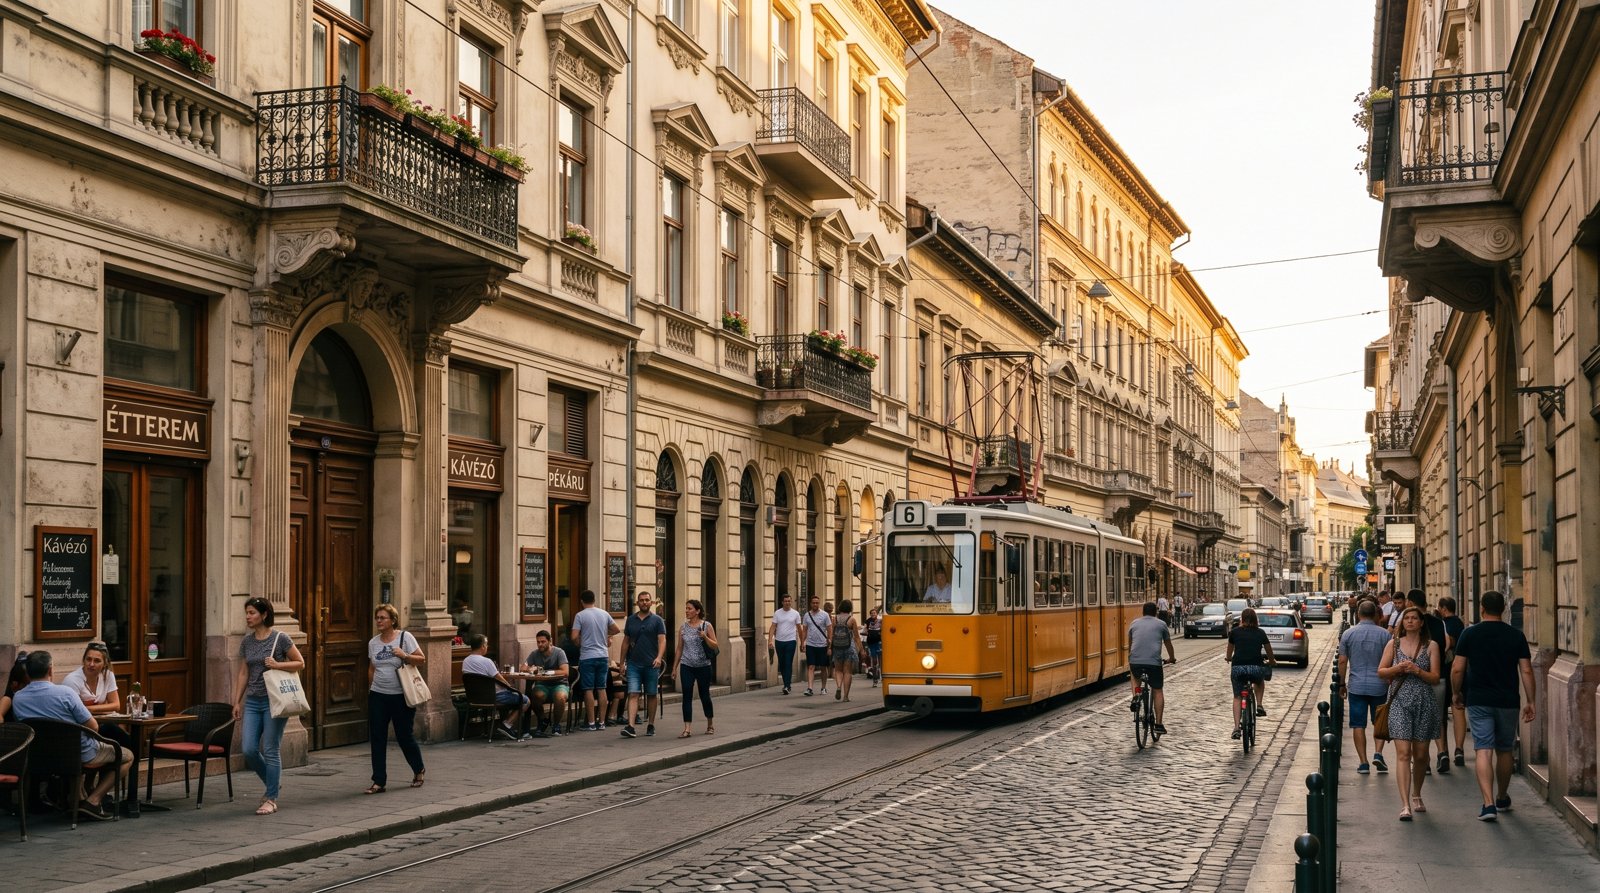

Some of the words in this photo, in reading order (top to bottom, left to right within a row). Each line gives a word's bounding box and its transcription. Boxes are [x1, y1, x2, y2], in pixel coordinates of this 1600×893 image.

[106, 404, 199, 443] ÉTTEREM
[451, 454, 496, 480] KÁVÉZÓ
[548, 468, 585, 491] PÉKÁRU
[904, 506, 915, 524] 6
[43, 537, 88, 554] Kávézó
[926, 623, 933, 634] 6
